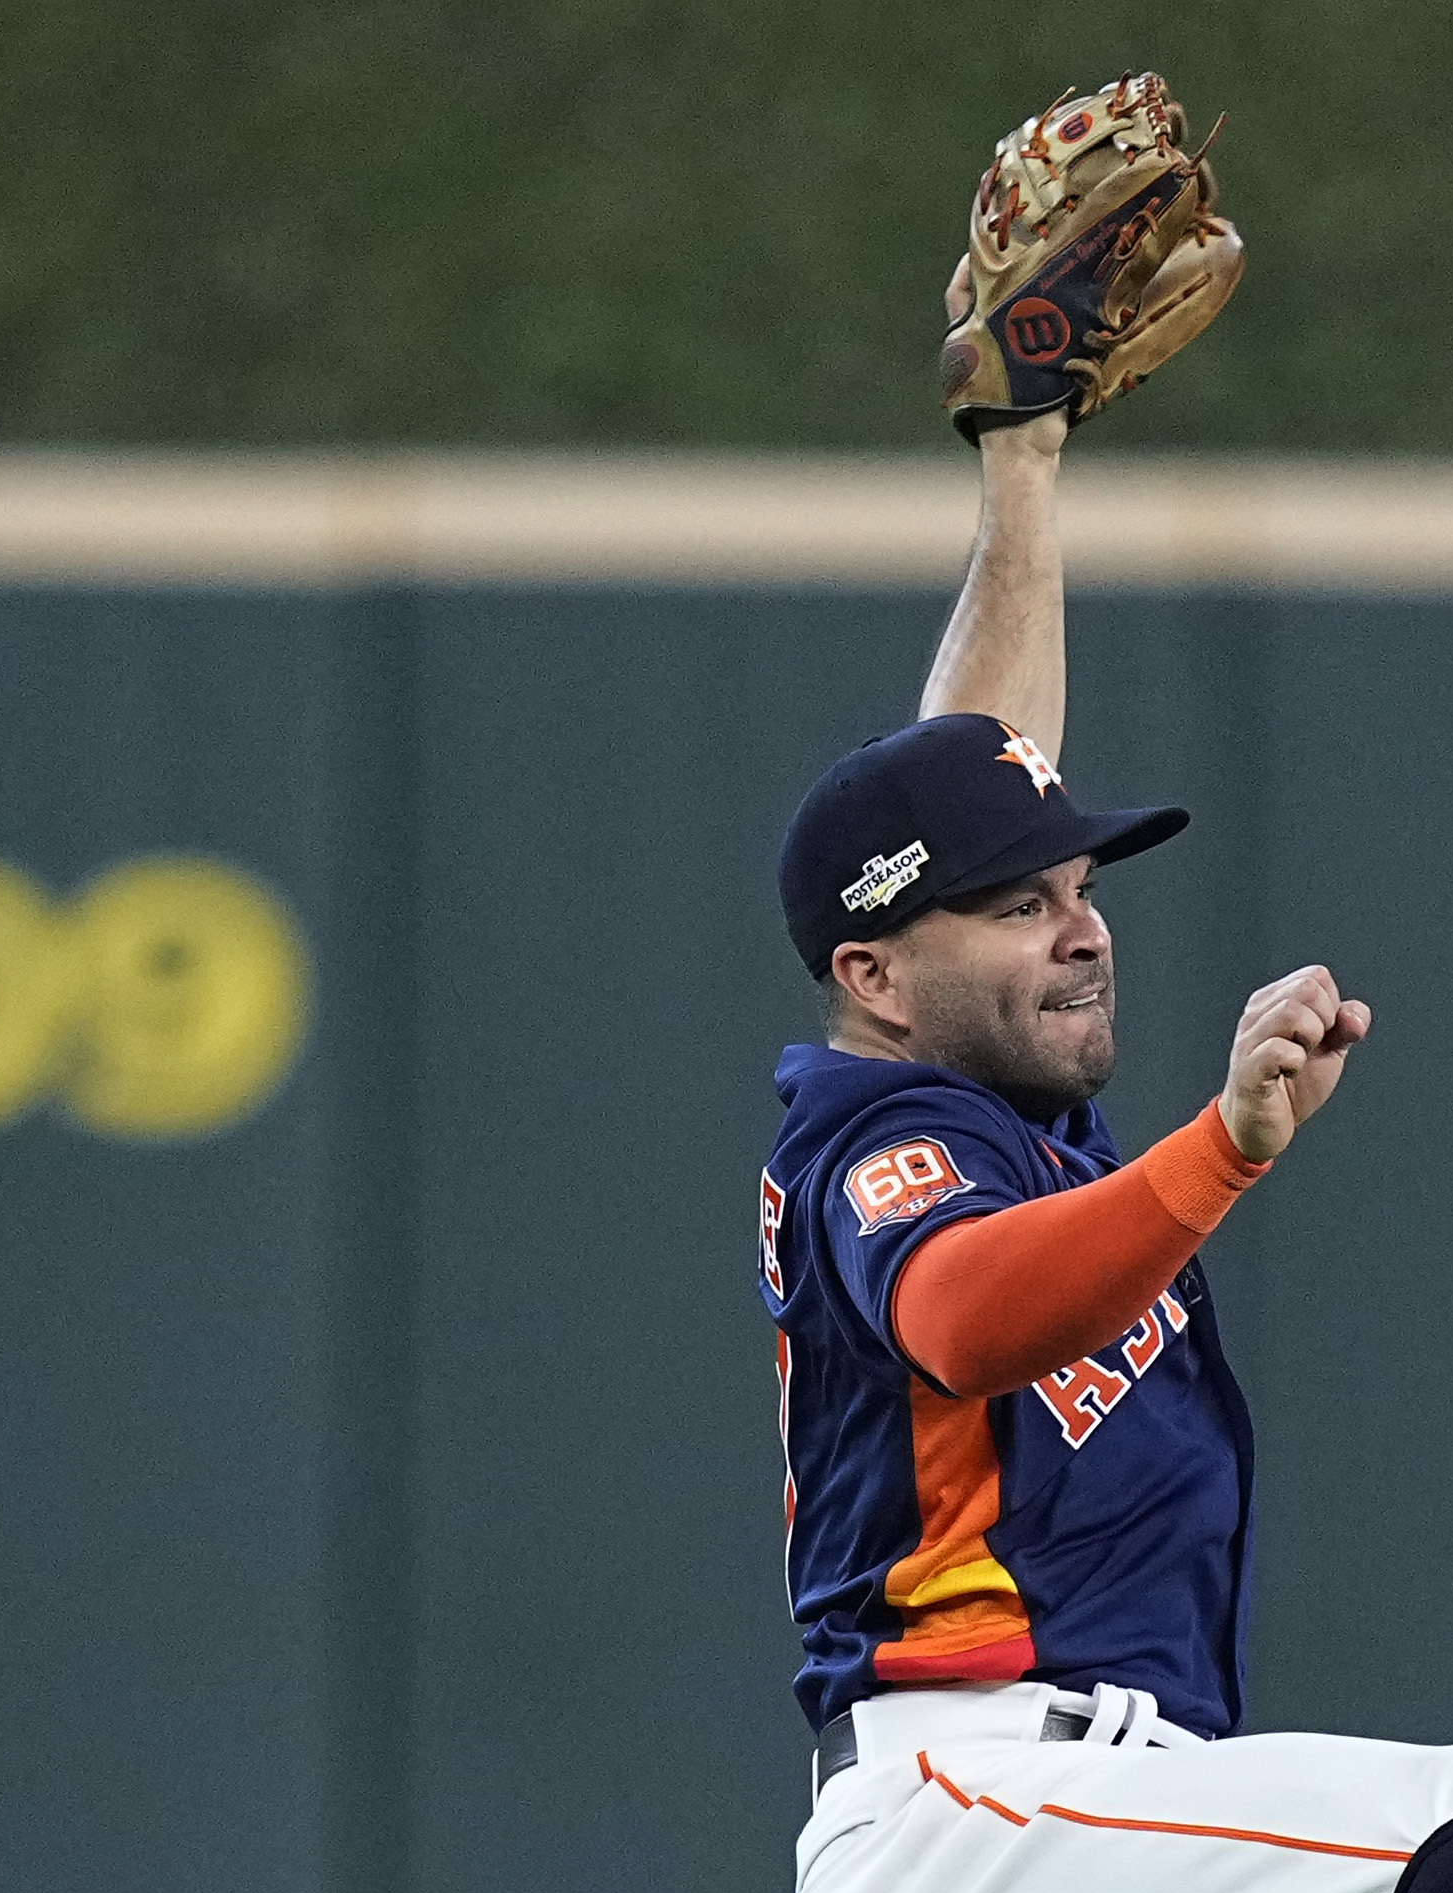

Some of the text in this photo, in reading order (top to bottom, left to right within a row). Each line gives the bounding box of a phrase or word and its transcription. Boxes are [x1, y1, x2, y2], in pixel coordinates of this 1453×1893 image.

[1002, 736, 1062, 789] H
[845, 847, 923, 906] POSTSEASON
[857, 1146, 945, 1207] 60
[757, 1166, 787, 1301] E
